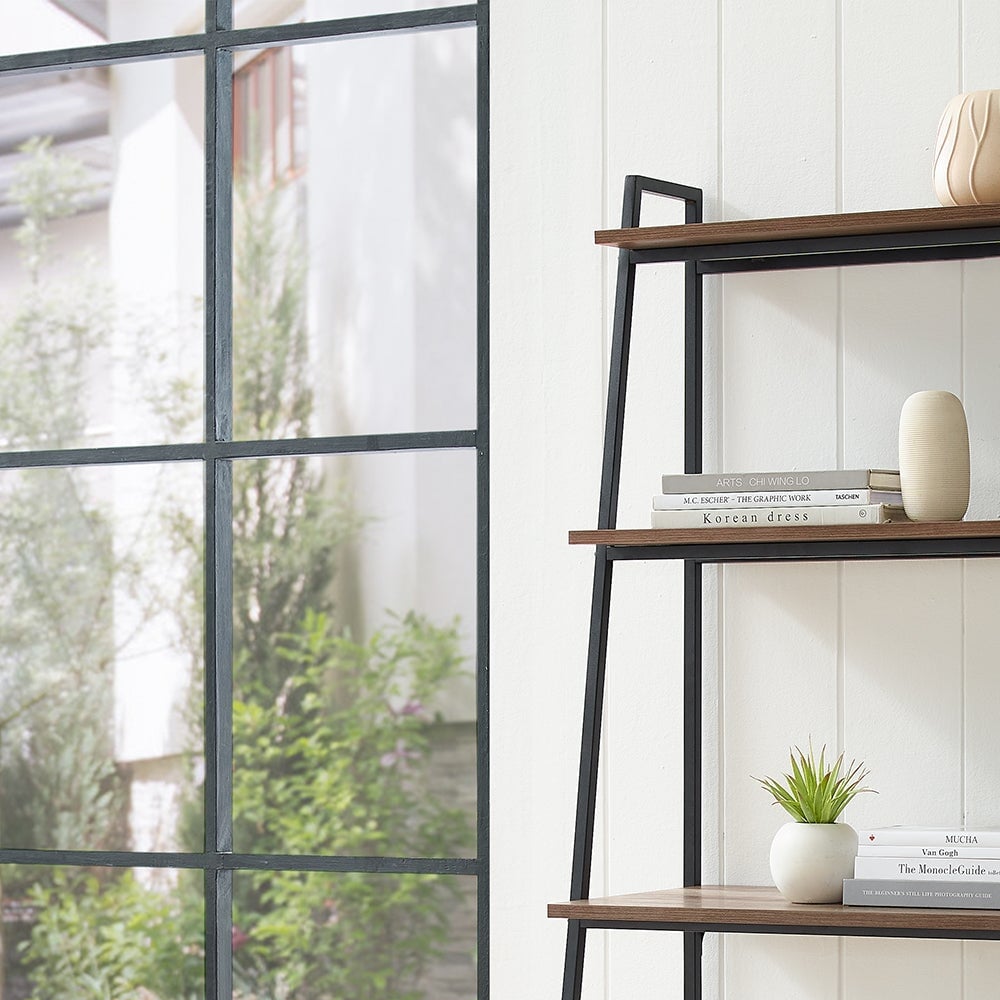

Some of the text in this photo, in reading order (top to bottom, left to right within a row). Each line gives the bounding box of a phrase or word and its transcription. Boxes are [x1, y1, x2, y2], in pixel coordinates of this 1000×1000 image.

[716, 476, 810, 487] ARTS CHI WING LO
[753, 494, 787, 503] GRAPHIC
[788, 494, 811, 502] WORK
[702, 511, 809, 524] Korean dress
[945, 836, 978, 844] MUCHA
[938, 849, 959, 858] Gogh
[898, 864, 916, 874] The
